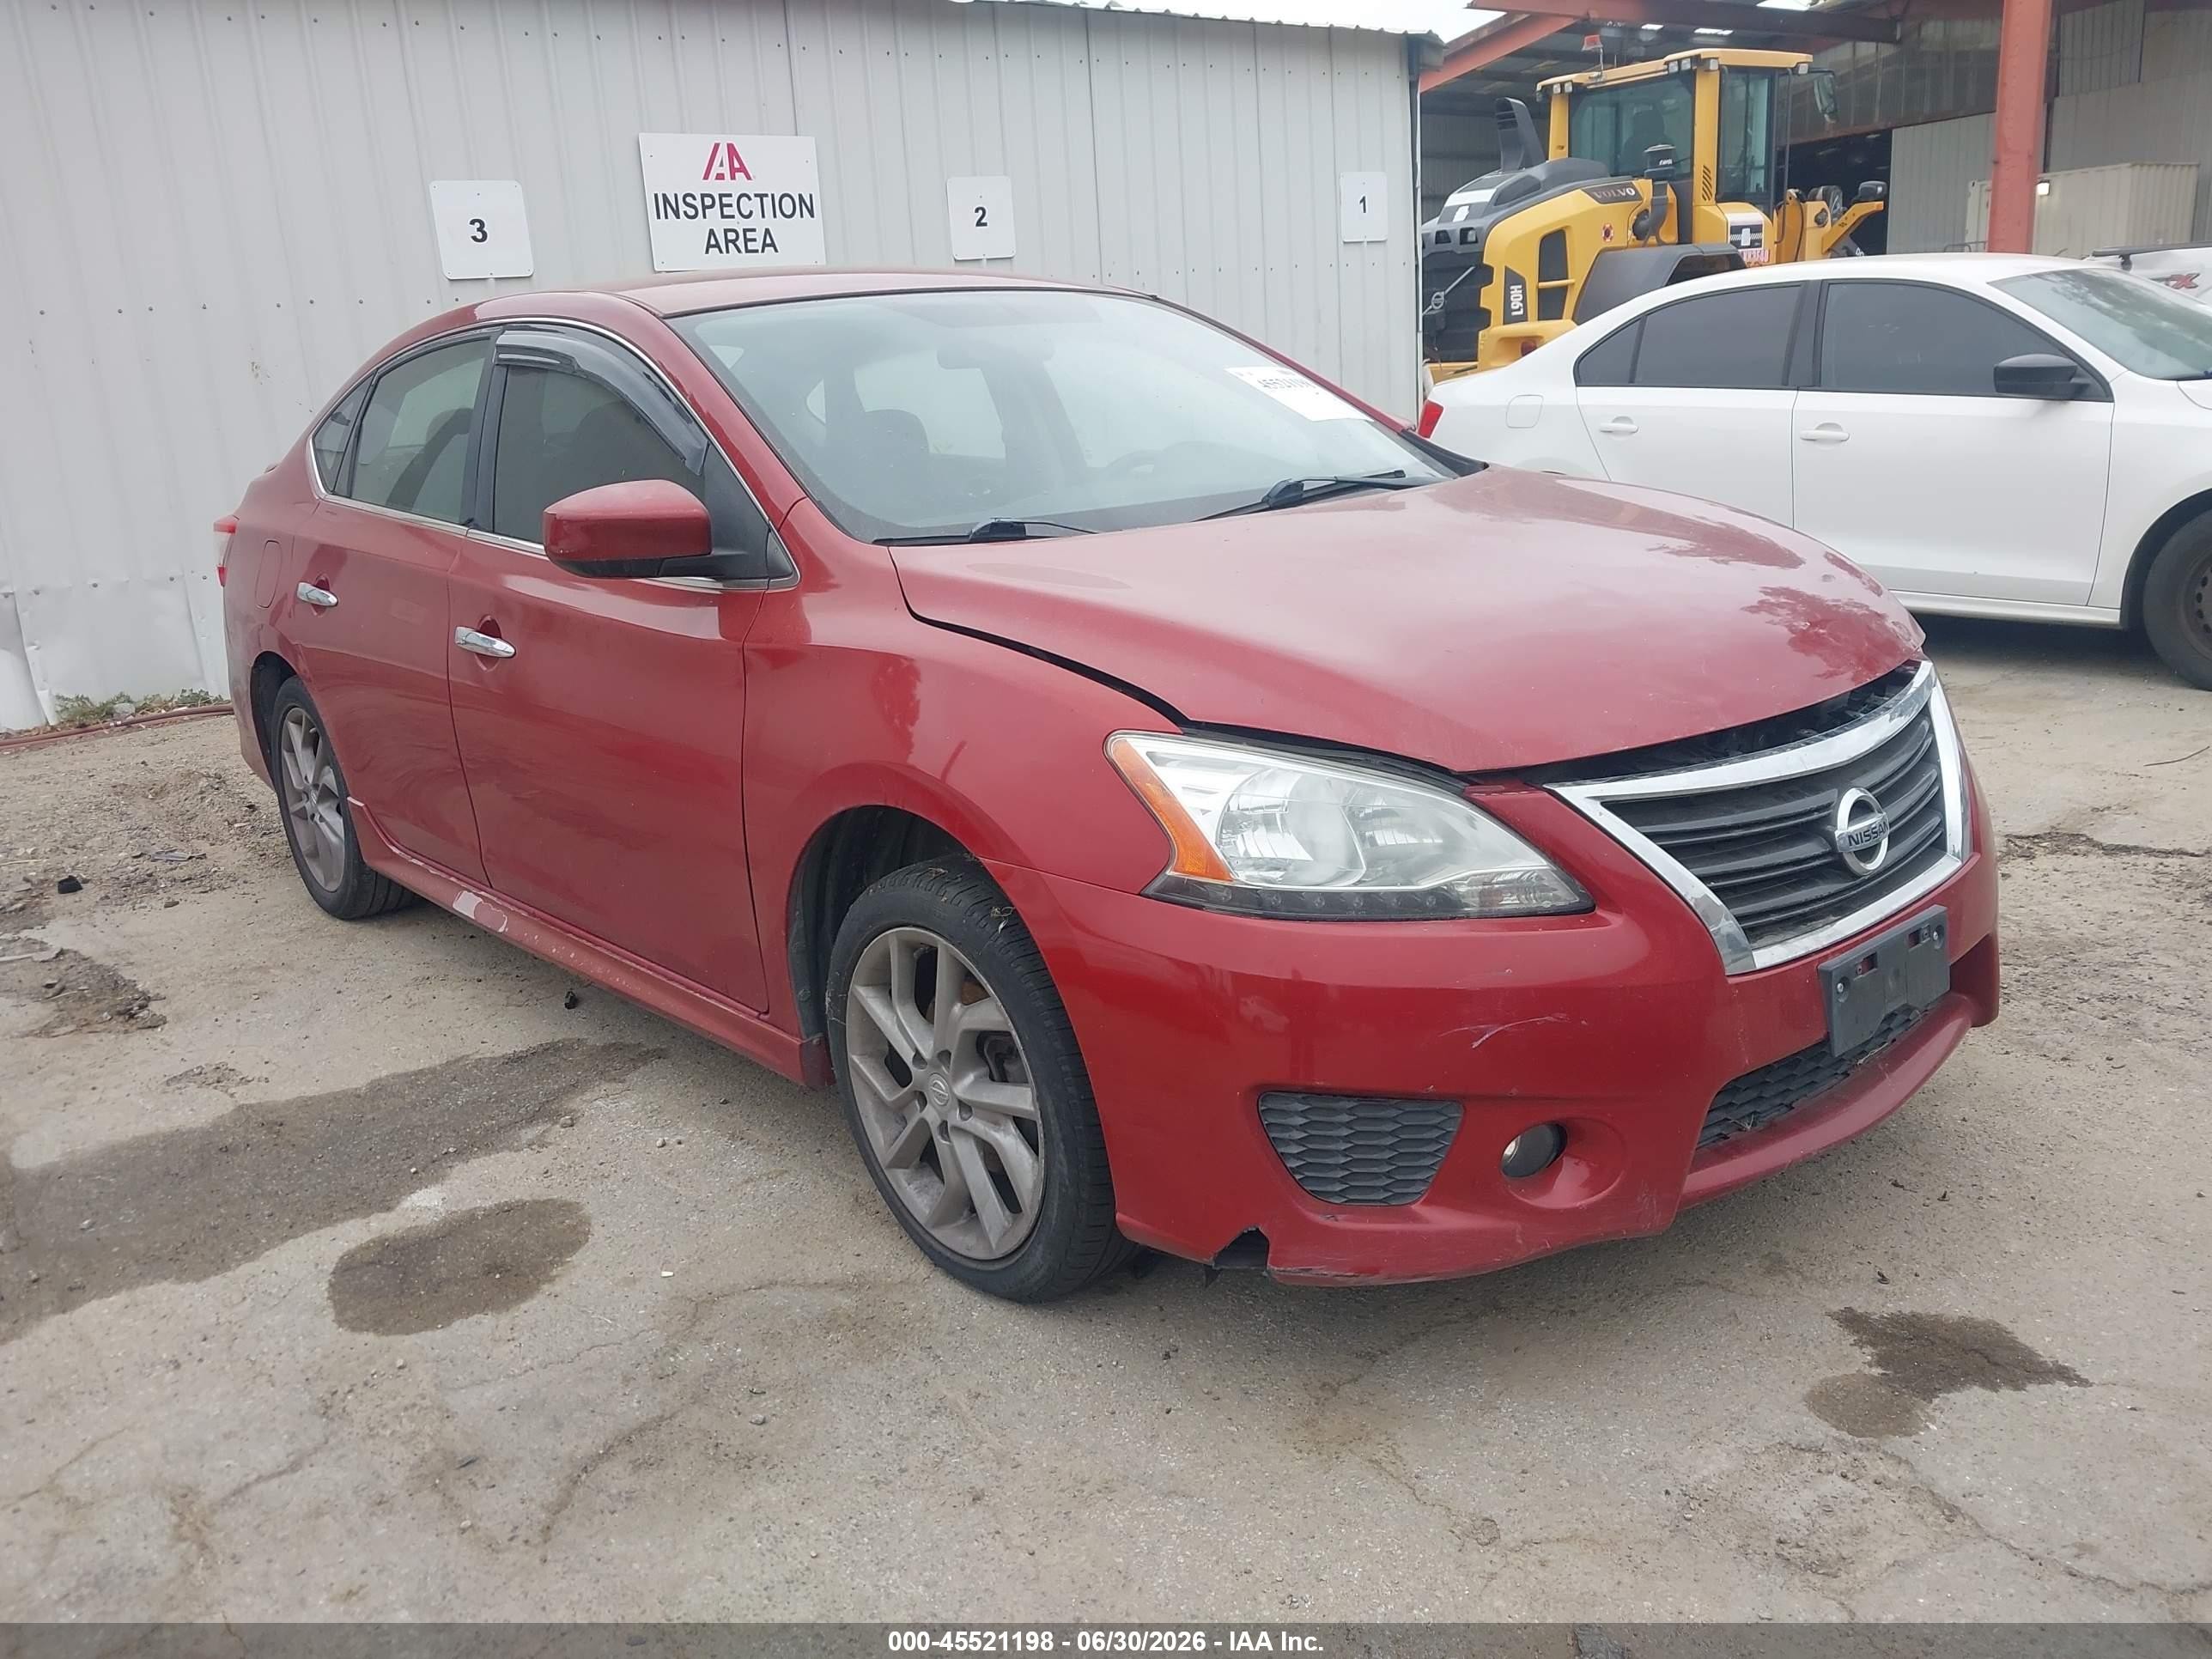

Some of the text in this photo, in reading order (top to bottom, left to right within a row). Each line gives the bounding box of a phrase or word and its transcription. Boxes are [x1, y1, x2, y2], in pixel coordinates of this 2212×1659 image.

[1359, 196, 1367, 214] 1
[1592, 187, 1636, 198] VOLVO
[653, 192, 815, 220] INSPECTION
[974, 206, 988, 228] 2
[469, 218, 488, 243] 3
[704, 228, 779, 254] AREA
[1510, 284, 1524, 316] L90H
[1847, 820, 1889, 847] NISSAN
